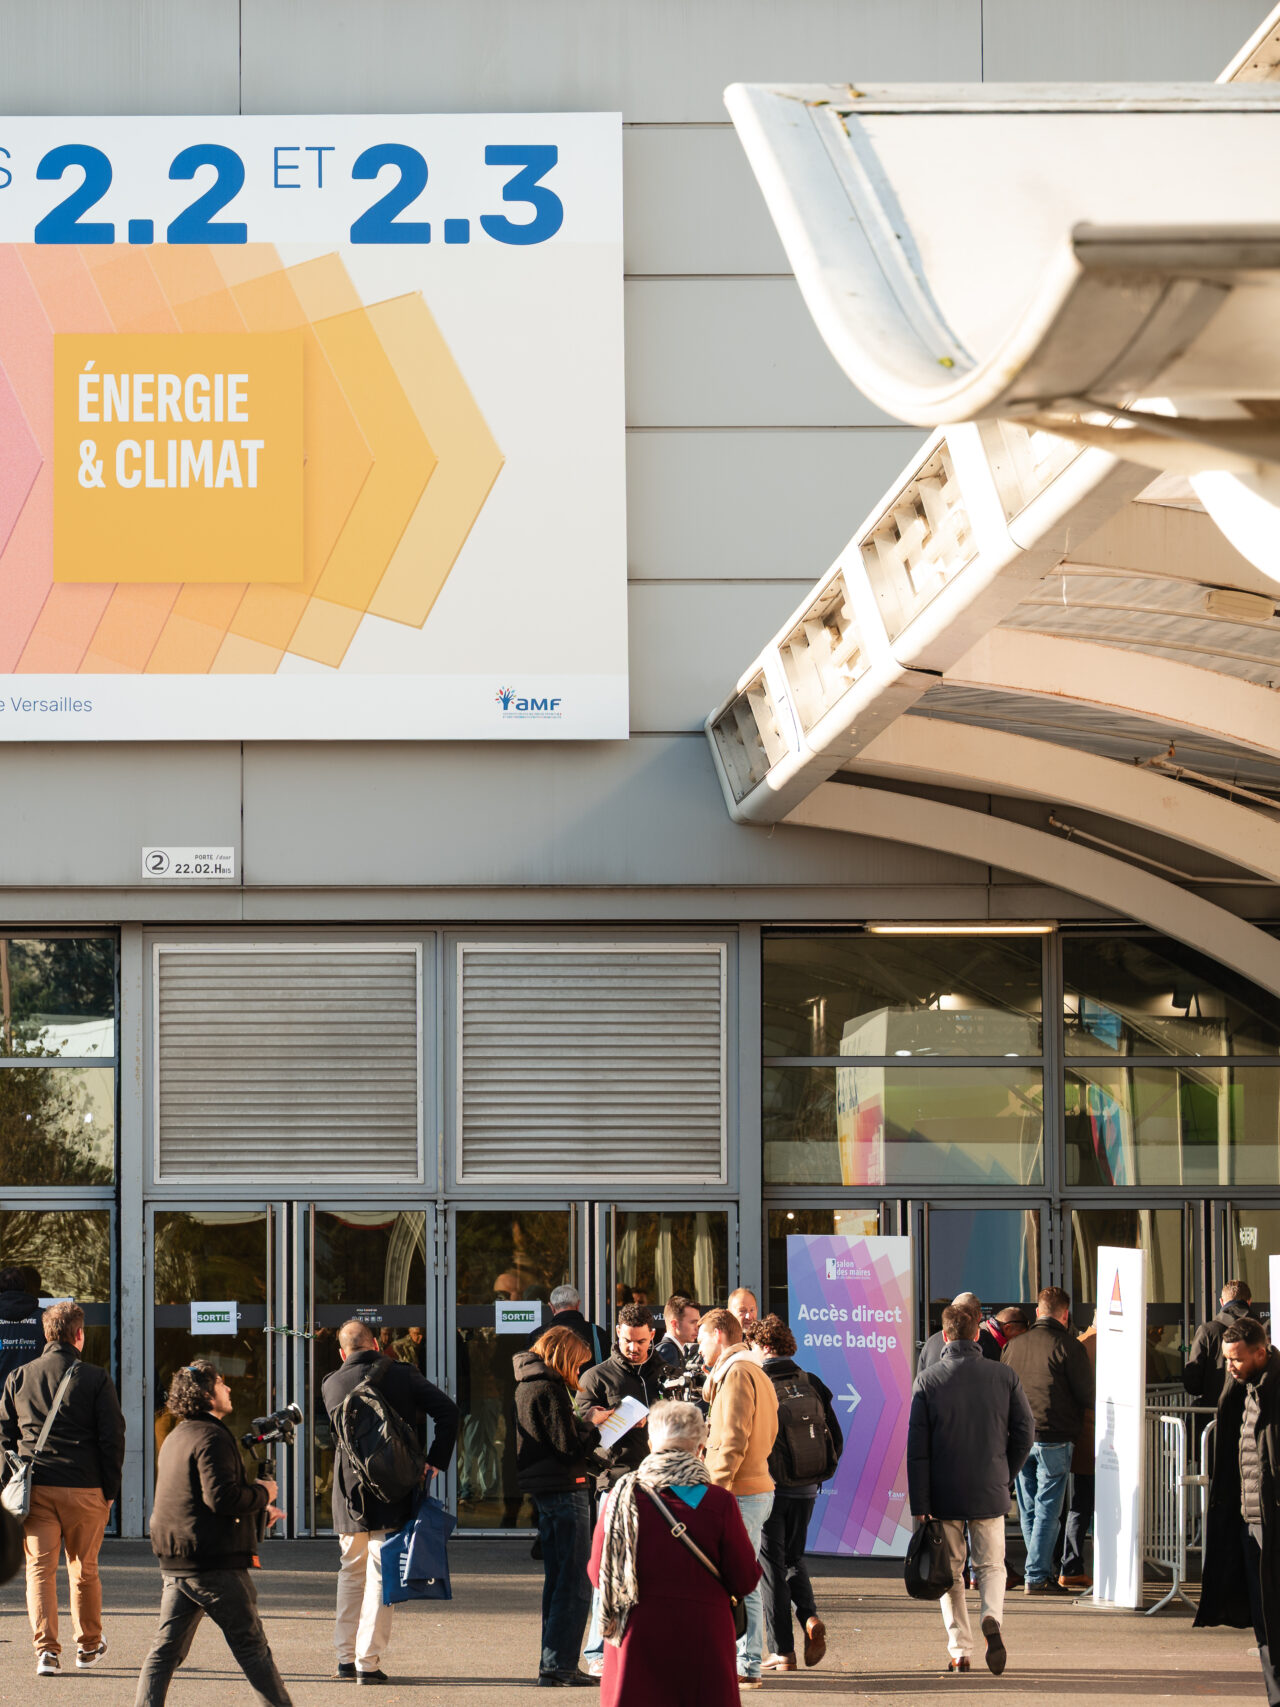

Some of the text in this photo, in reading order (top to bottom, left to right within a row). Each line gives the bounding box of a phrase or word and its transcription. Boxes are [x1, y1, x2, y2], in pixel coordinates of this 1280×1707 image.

[33, 143, 248, 245] 2.2
[273, 146, 336, 189] ET
[350, 142, 564, 246] 2.3
[78, 360, 249, 422] ÉNERGIE
[78, 439, 265, 489] & CLIMAT
[10, 696, 93, 712] Versailles
[151, 854, 164, 871] 2
[836, 1259, 855, 1268] salon
[197, 1314, 231, 1322] SORTIE
[501, 1313, 536, 1322] SORTIE
[797, 1303, 903, 1323] Accès direct
[803, 1330, 897, 1353] avec badge
